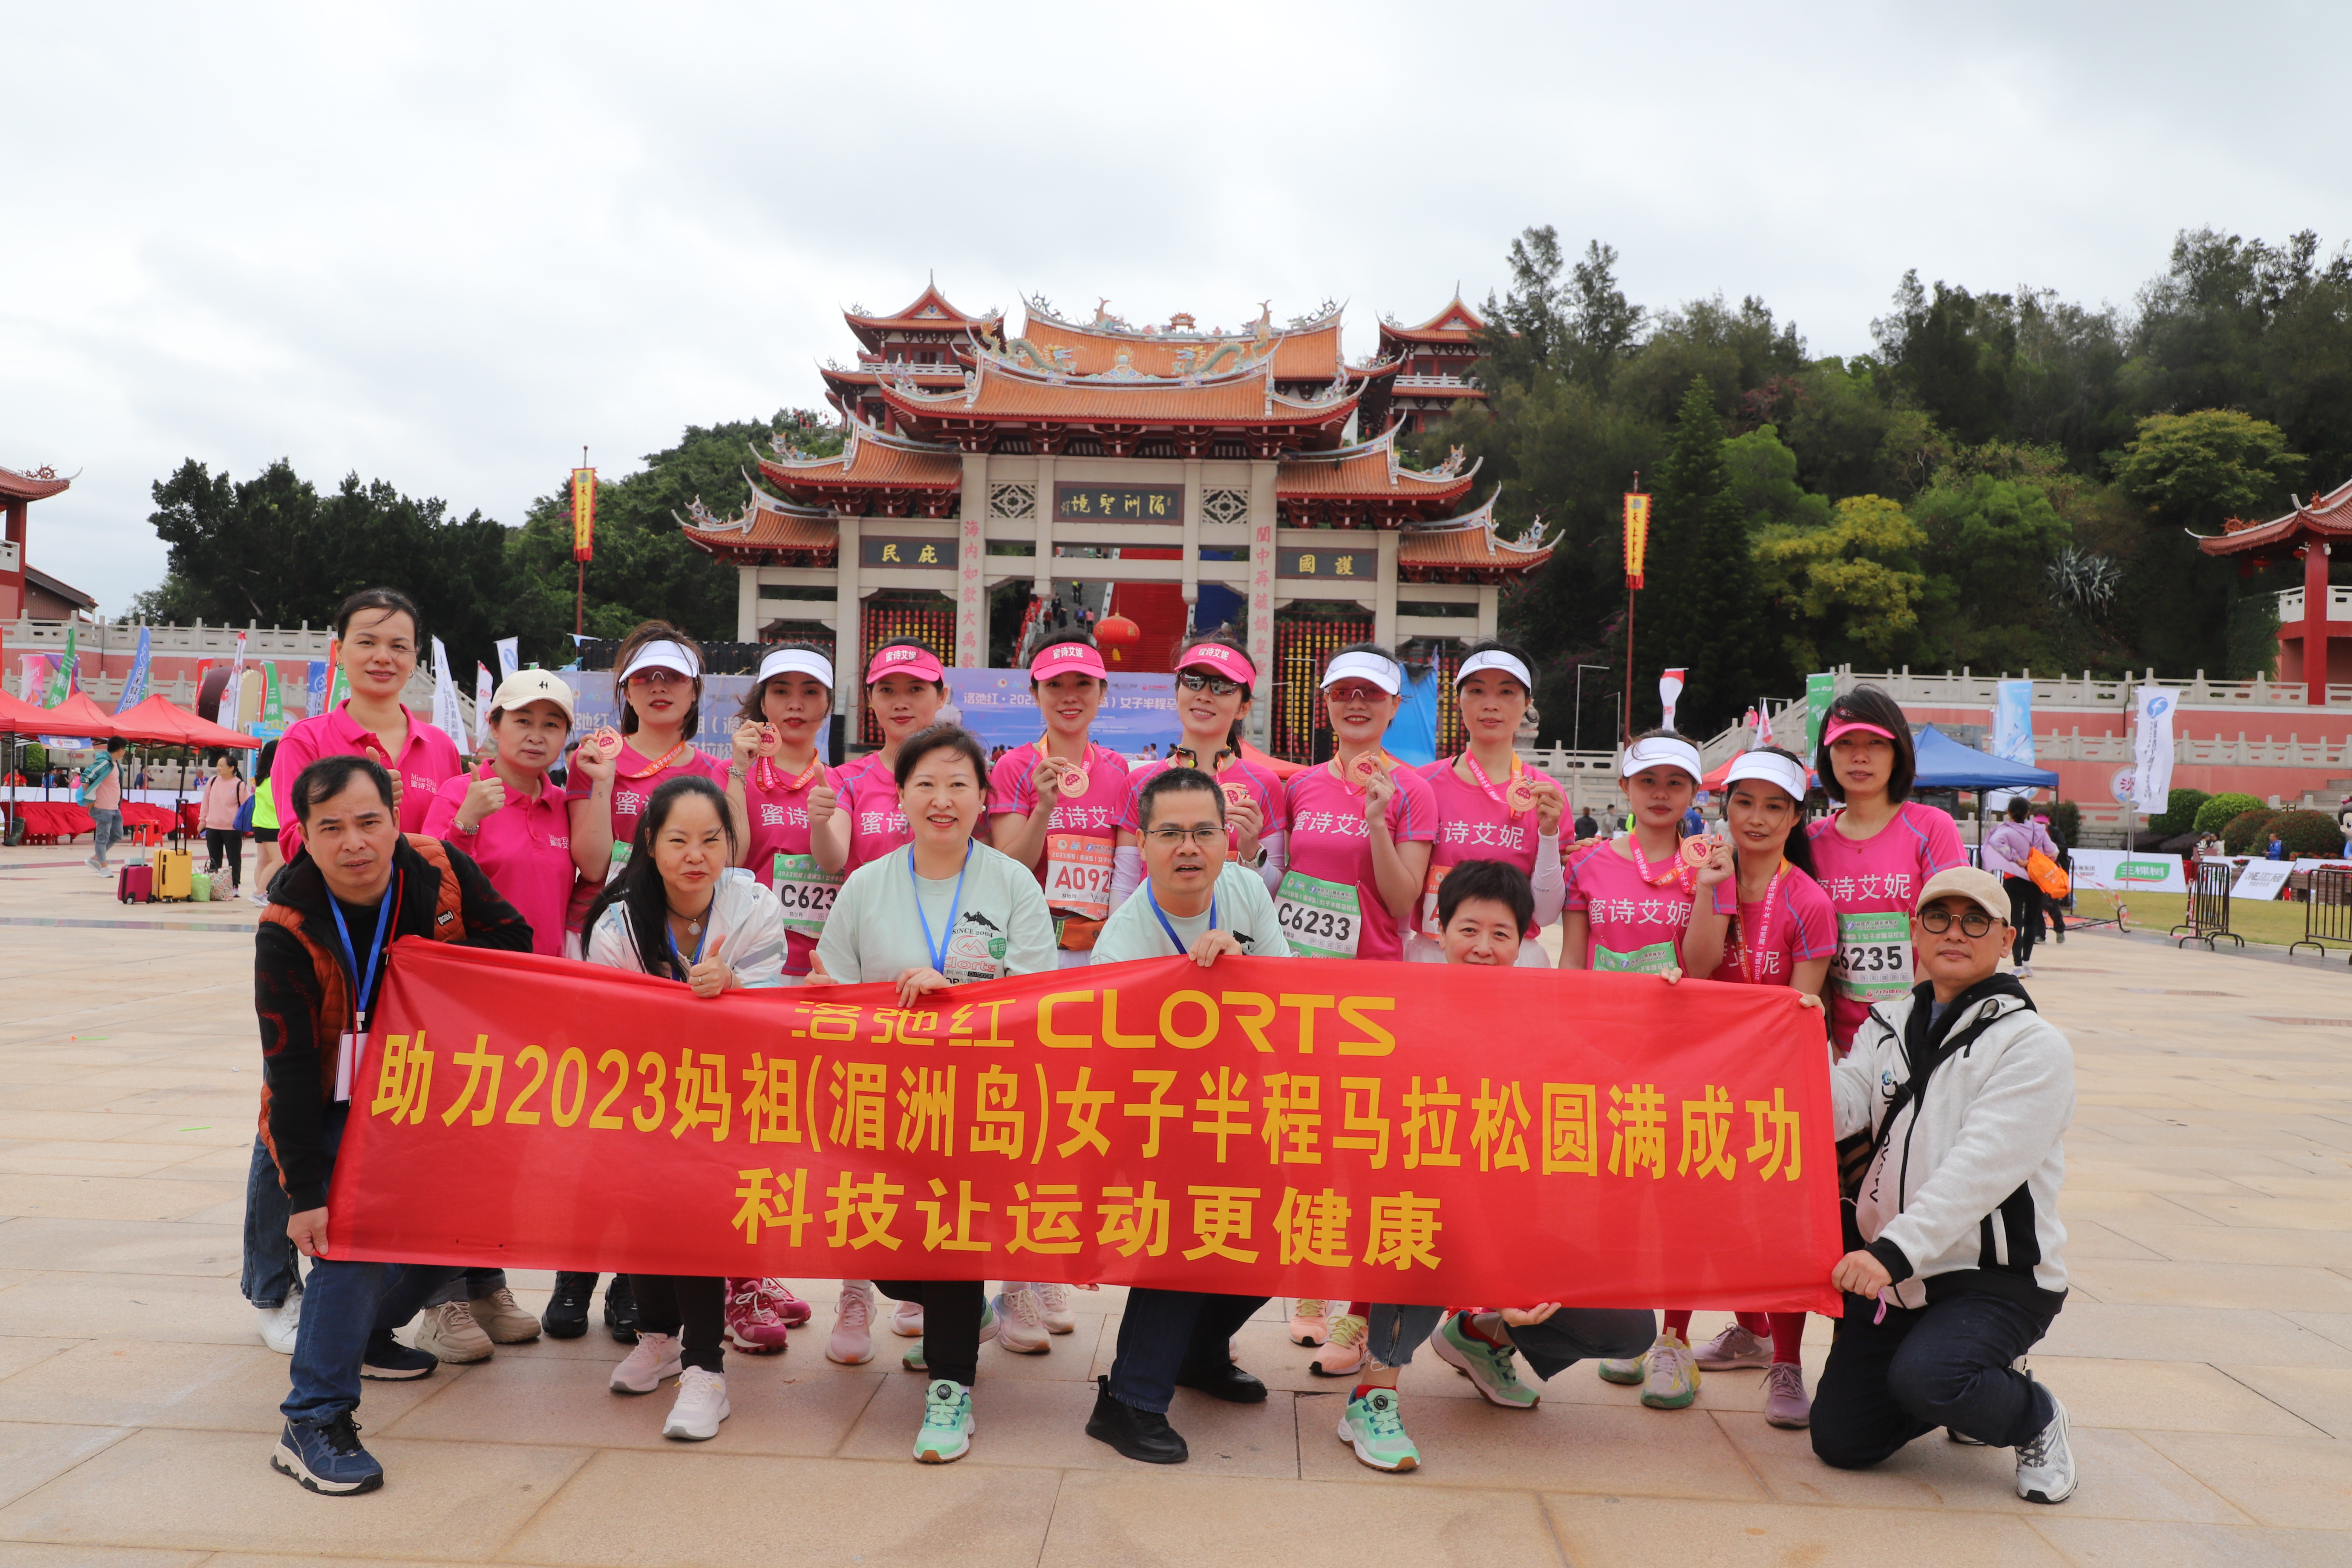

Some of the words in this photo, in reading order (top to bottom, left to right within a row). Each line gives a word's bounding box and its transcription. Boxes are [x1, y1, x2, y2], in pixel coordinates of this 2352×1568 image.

[882, 544, 938, 564] 庇民
[1299, 554, 1354, 575] 護國
[885, 649, 917, 663] 蜜诗艾妮
[1053, 646, 1083, 659] 蜜诗艾妮
[1197, 647, 1230, 660] 蜜诗艾妮
[410, 781, 437, 794] 蜜诗艾妮
[615, 790, 650, 816] 蜜
[1047, 805, 1115, 830] 蜜诗艾
[1435, 820, 1525, 851] 诗艾妮
[2121, 865, 2164, 877] 三棵树
[1278, 903, 1350, 940] C6233
[1589, 898, 1692, 928] 蜜诗艾妮
[990, 943, 1006, 952] 莆田
[944, 956, 996, 972] Clorts
[791, 998, 1017, 1048] 洛弛红
[1037, 988, 1397, 1058] CLORTS
[371, 1029, 1801, 1182] 助力2023妈祖(湄洲岛)女子半程马拉松圆满成功
[731, 1167, 1442, 1271] 科技让运动更健康
